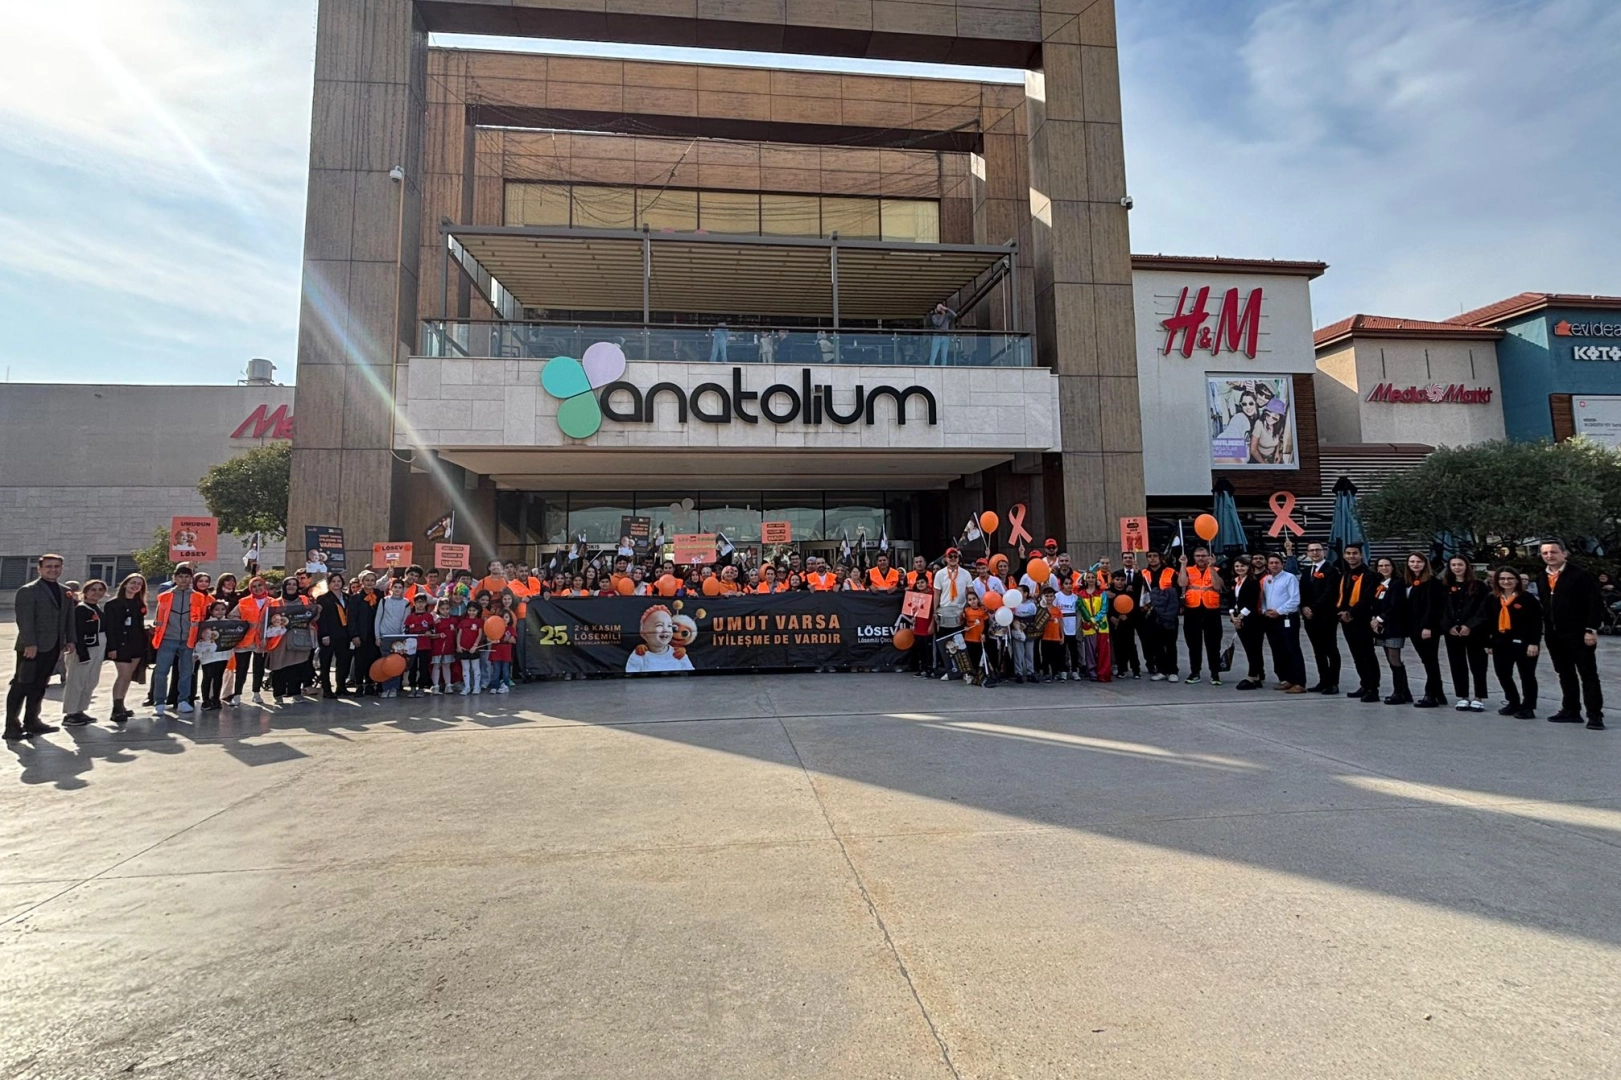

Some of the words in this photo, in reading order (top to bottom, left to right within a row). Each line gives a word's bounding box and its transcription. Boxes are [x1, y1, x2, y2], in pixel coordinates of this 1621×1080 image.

[1160, 285, 1263, 360] H&M
[1571, 322, 1621, 337] evidea
[599, 366, 938, 426] anatolium
[1366, 382, 1428, 404] Media
[1440, 383, 1493, 404] Markt
[592, 624, 621, 632] KASIM
[712, 616, 769, 632] UMUT
[775, 614, 841, 630] VARSA
[857, 624, 898, 637] LÖSEV
[539, 625, 571, 646] 25.
[712, 633, 770, 648] İYİLEŞME
[774, 634, 789, 644] DE
[794, 633, 841, 644] VARDIR
